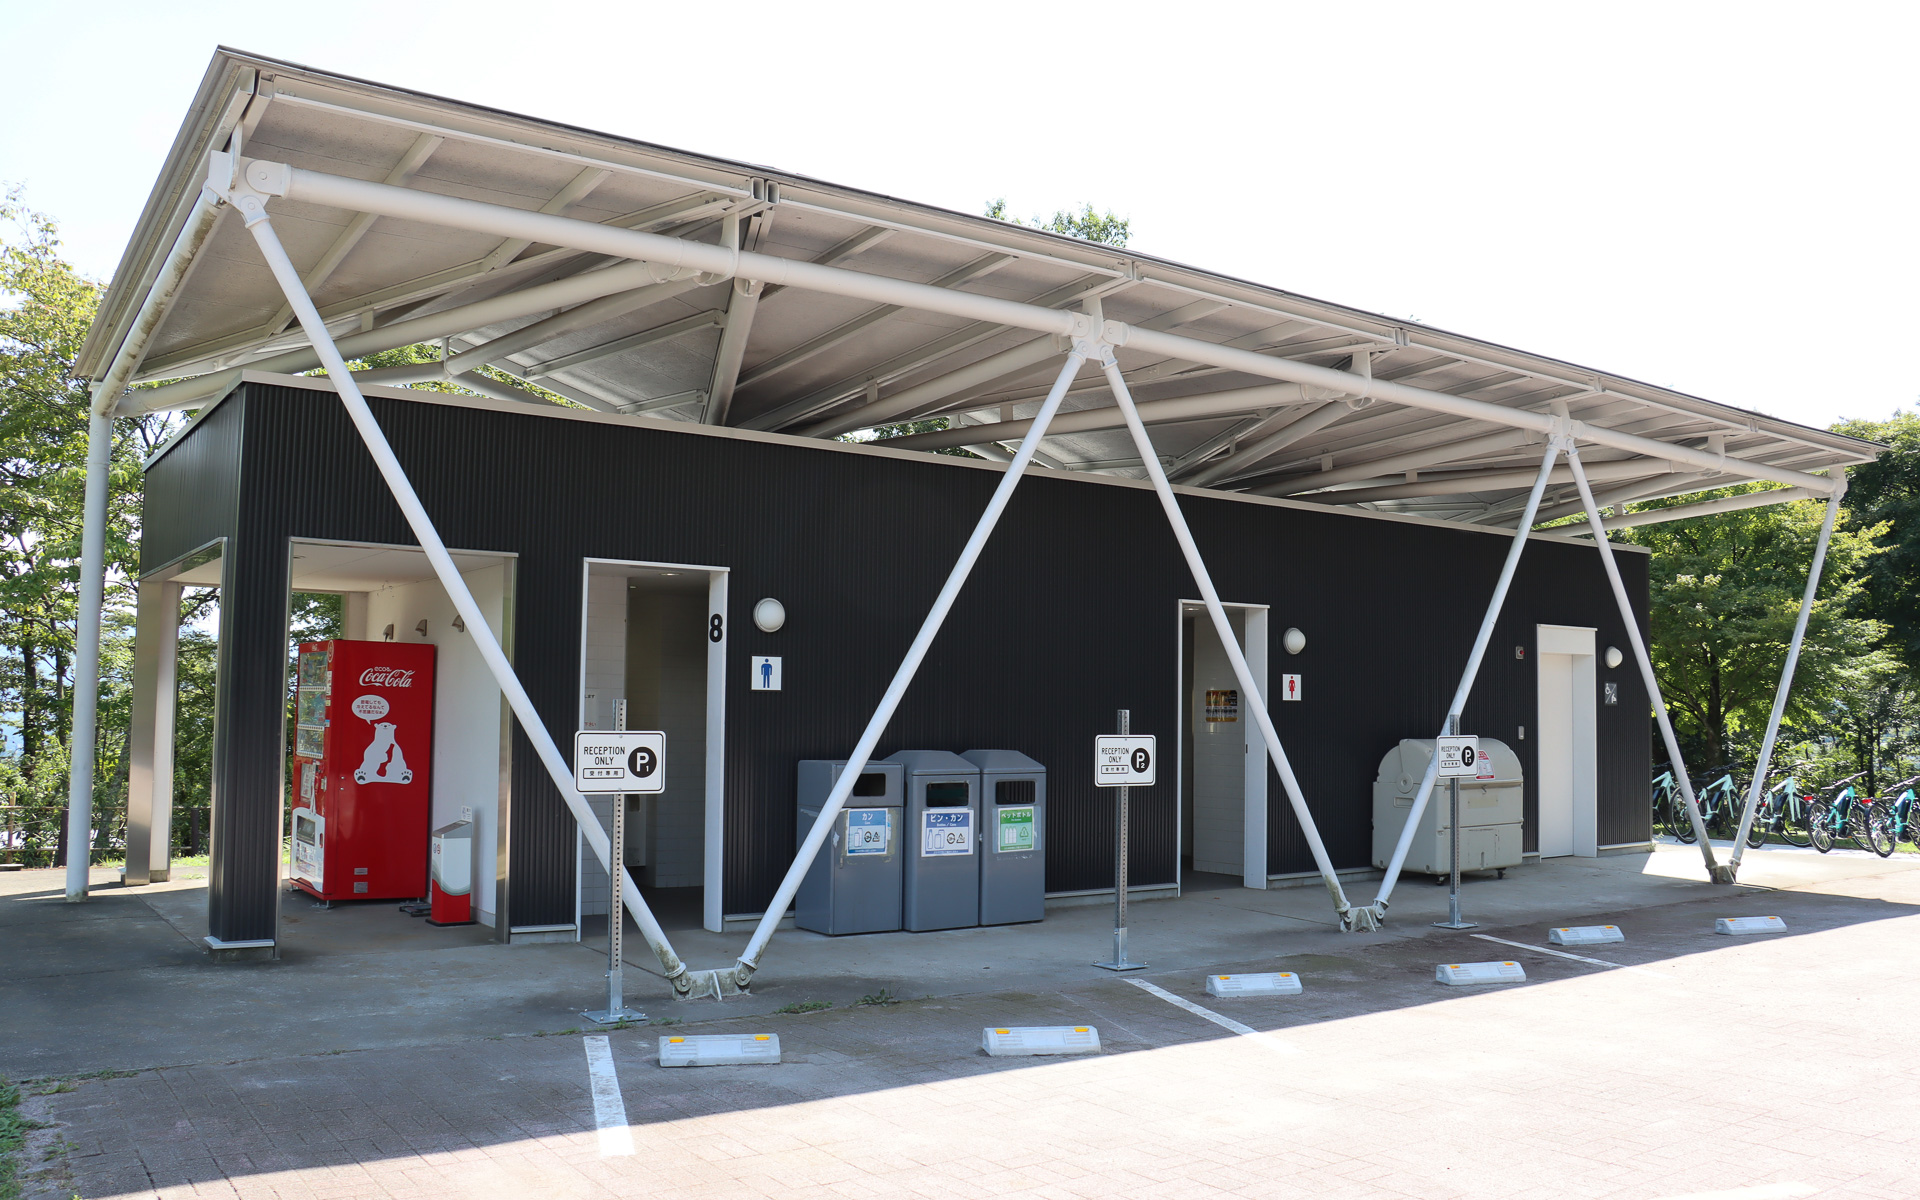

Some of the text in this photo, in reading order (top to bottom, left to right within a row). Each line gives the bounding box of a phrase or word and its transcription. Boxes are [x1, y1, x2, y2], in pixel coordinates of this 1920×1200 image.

[709, 613, 723, 643] 8
[359, 668, 415, 688] Coca-Cola
[584, 746, 625, 755] RECEPTION
[1102, 747, 1129, 755] RECEPTION
[595, 756, 614, 766] ONLY
[862, 812, 873, 821] カン
[1001, 811, 1032, 819] ペットボトル
